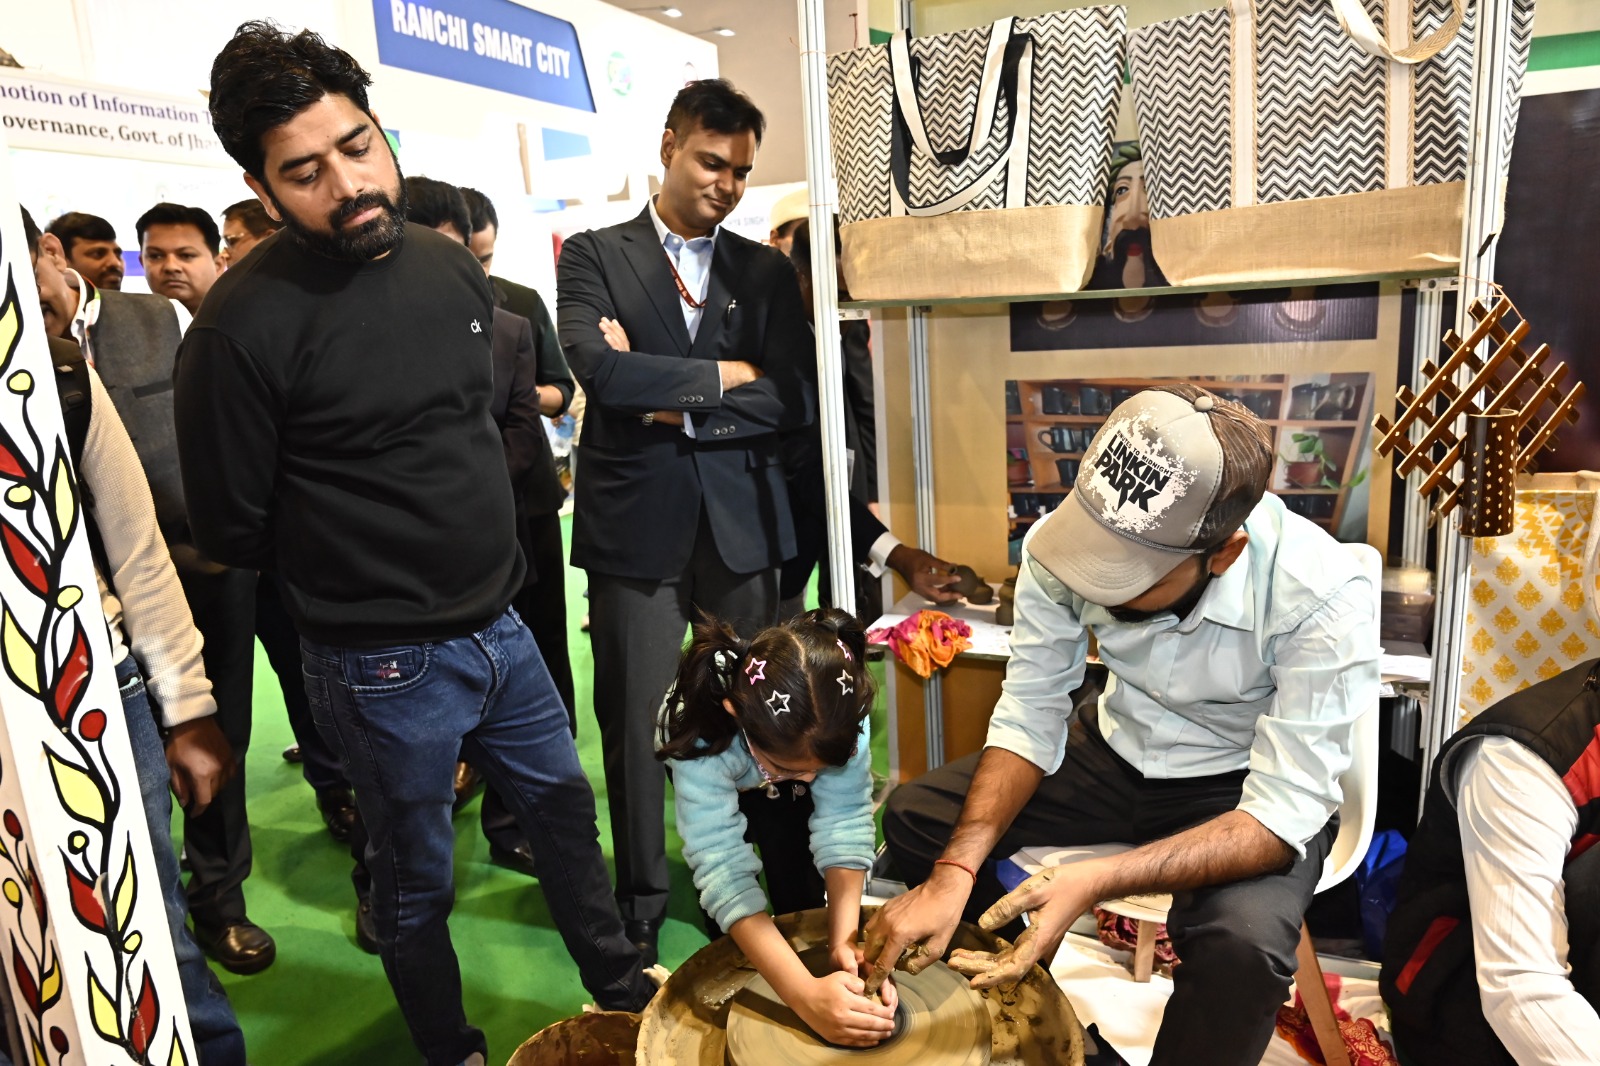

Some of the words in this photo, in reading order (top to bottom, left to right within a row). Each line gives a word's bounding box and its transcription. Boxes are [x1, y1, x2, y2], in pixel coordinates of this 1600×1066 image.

[390, 0, 469, 51] RANCHI
[472, 22, 533, 69] SMART
[536, 42, 571, 79] CITY
[3, 114, 114, 141] overnance,
[118, 125, 164, 145] Govt.
[168, 132, 184, 147] of
[69, 92, 88, 108] of
[92, 93, 199, 123] Information
[1094, 448, 1161, 513] PARK
[1107, 433, 1171, 492] LINKIN
[1132, 447, 1141, 456] TO
[1141, 455, 1174, 477] MIDNIGHT
